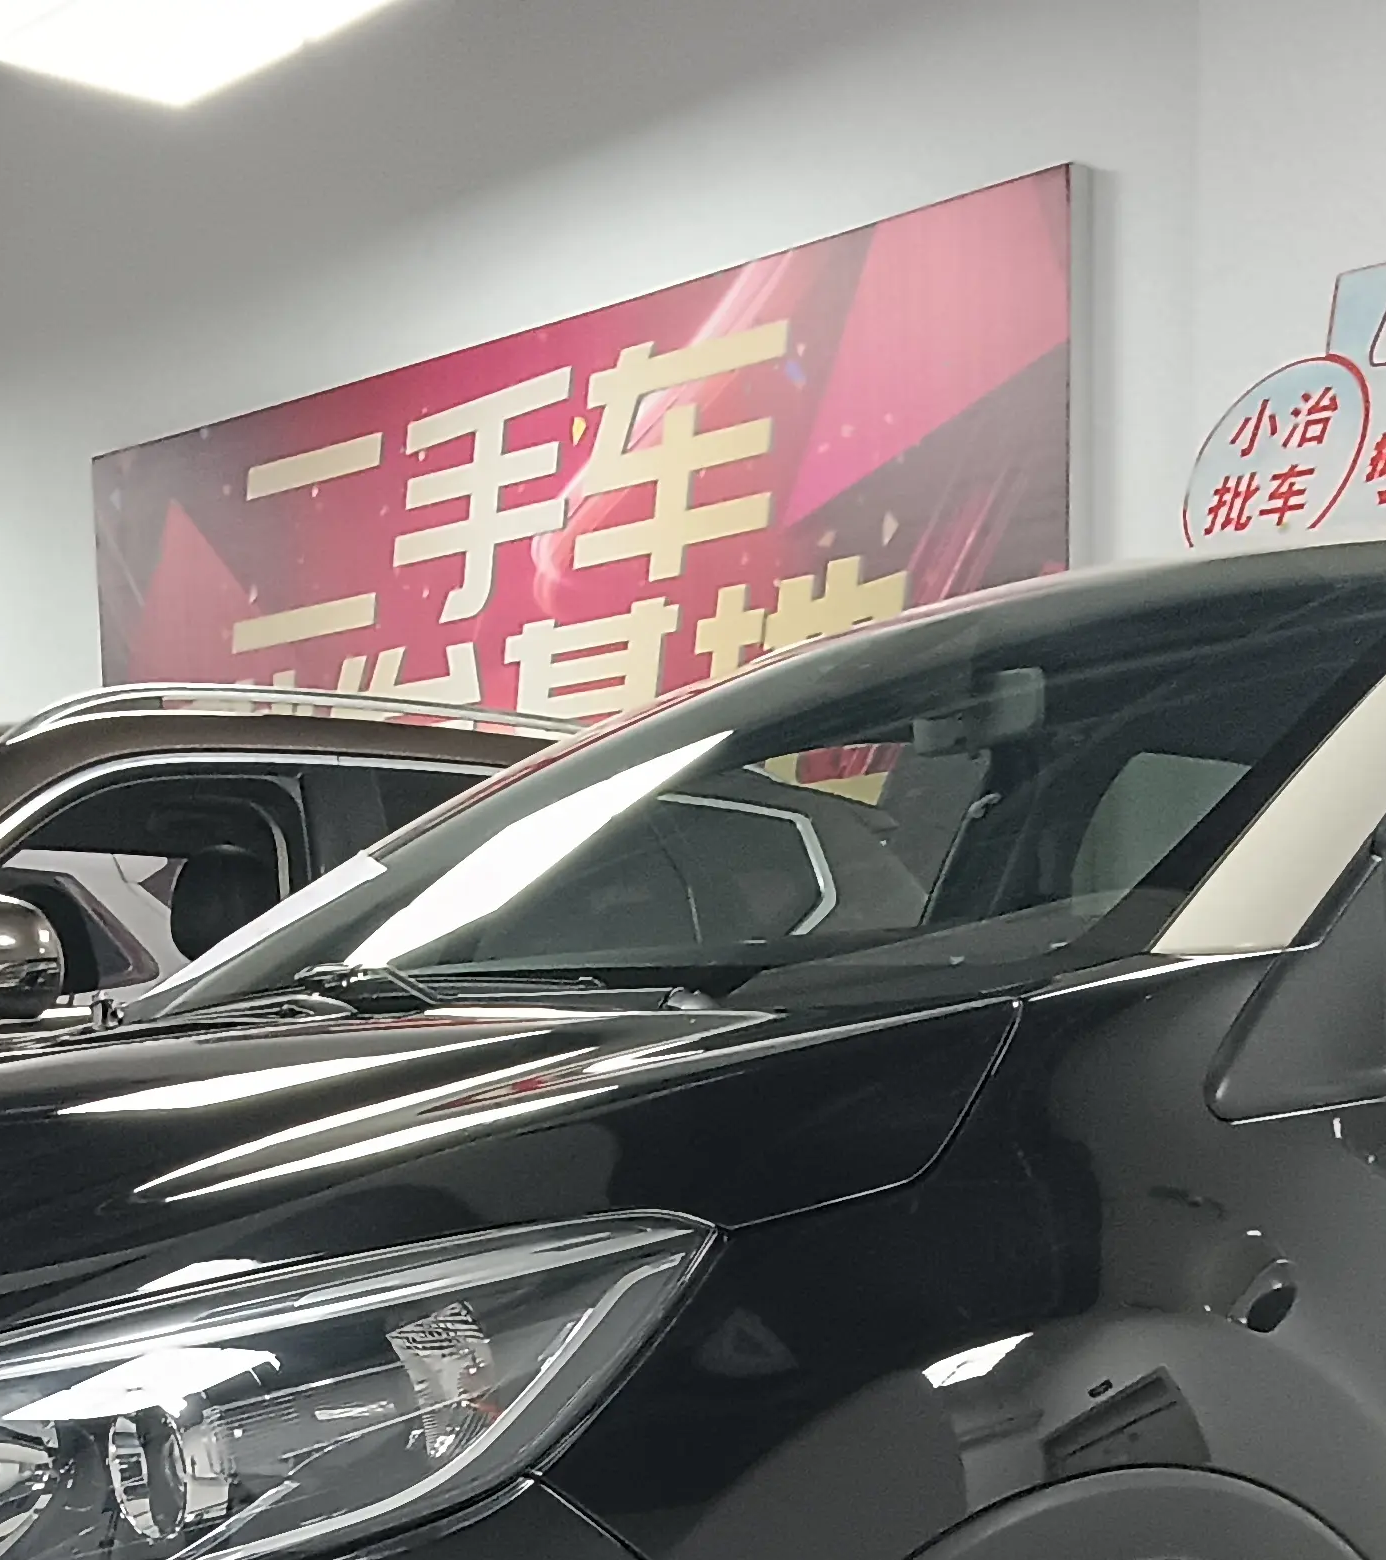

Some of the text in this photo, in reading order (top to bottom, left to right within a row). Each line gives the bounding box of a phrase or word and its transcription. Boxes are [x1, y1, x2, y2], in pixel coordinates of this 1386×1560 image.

[1228, 386, 1339, 459] 小治
[231, 319, 790, 654] 二手车
[1203, 465, 1316, 535] 批车
